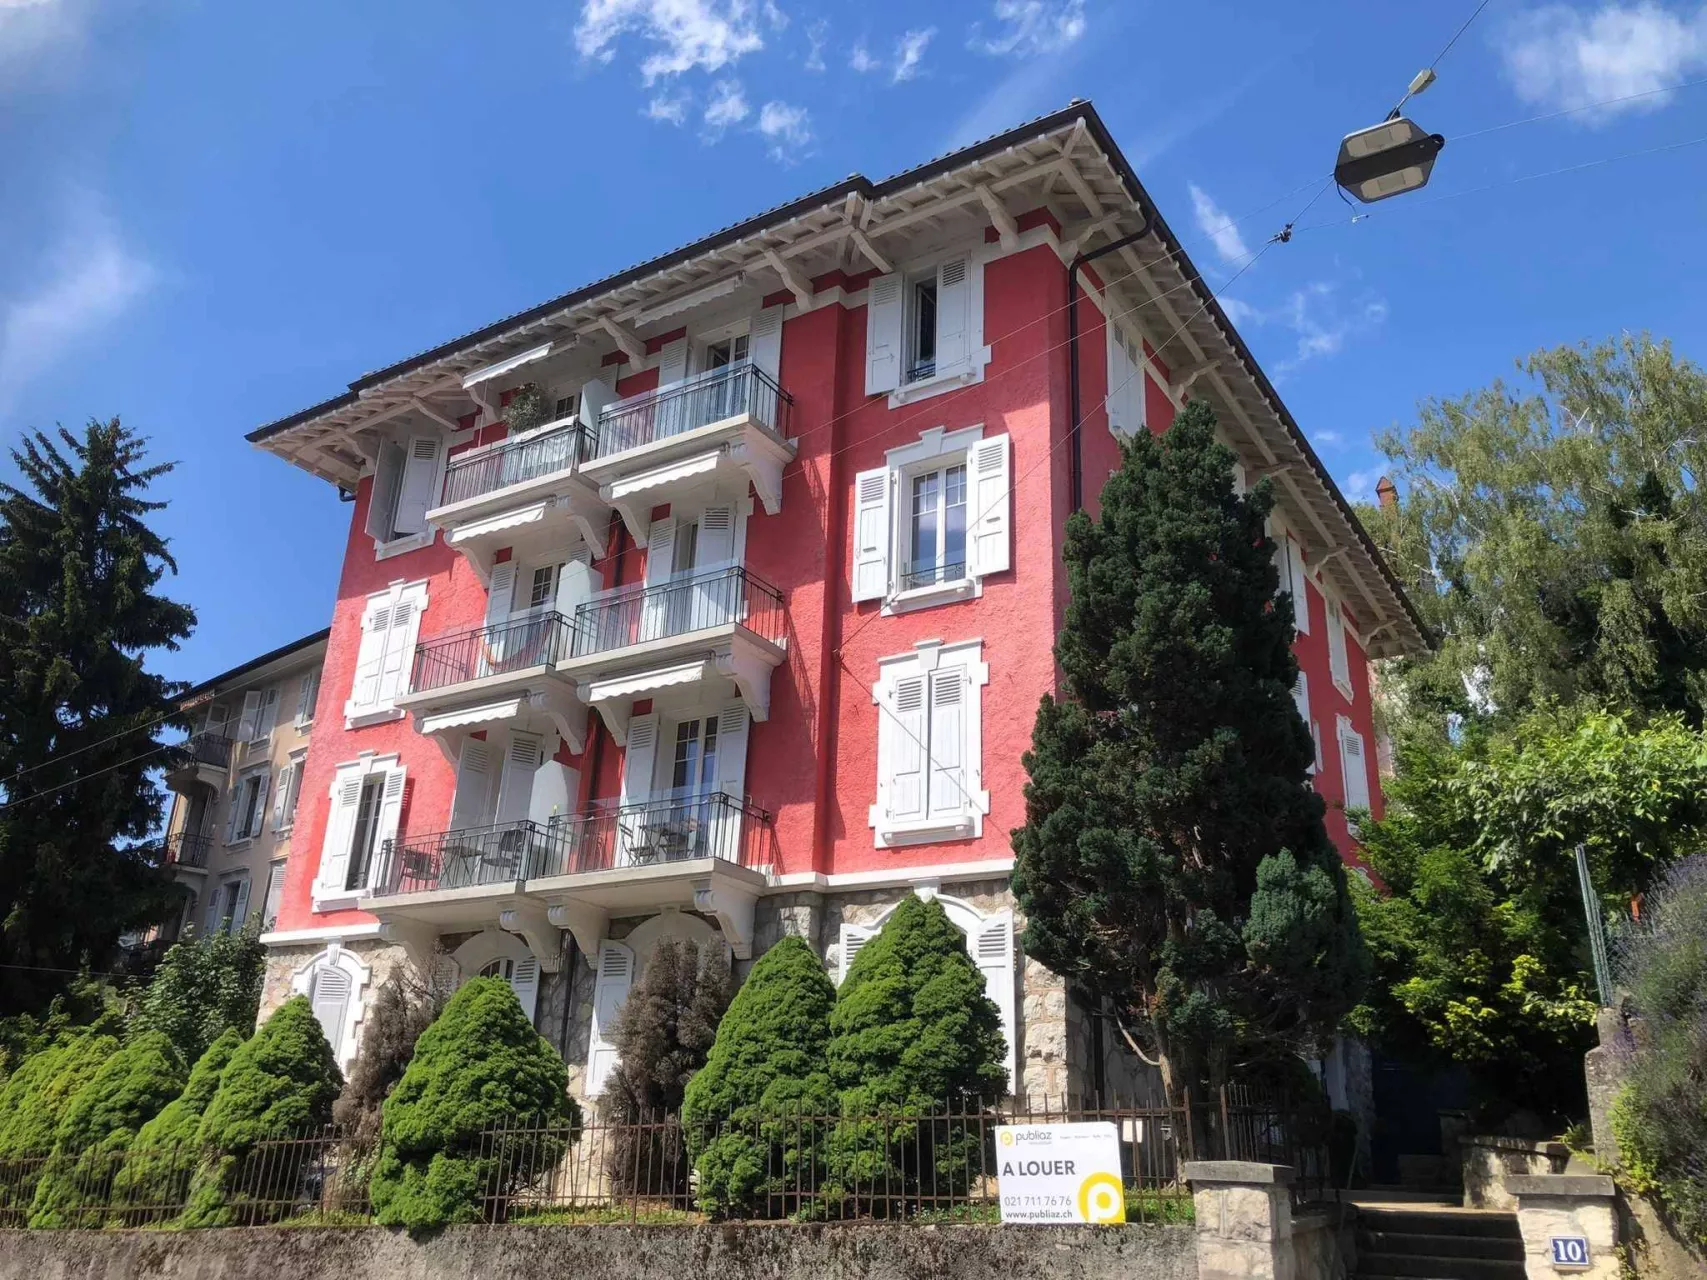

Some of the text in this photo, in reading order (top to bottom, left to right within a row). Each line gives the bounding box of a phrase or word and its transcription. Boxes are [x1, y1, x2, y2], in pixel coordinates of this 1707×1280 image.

[1016, 1130, 1052, 1145] publiaz
[1002, 1160, 1075, 1176] A LOUER
[1004, 1195, 1072, 1206] 021 711 76 76
[1005, 1210, 1073, 1219] www.publiaz.ch
[1556, 1240, 1582, 1261] 10
